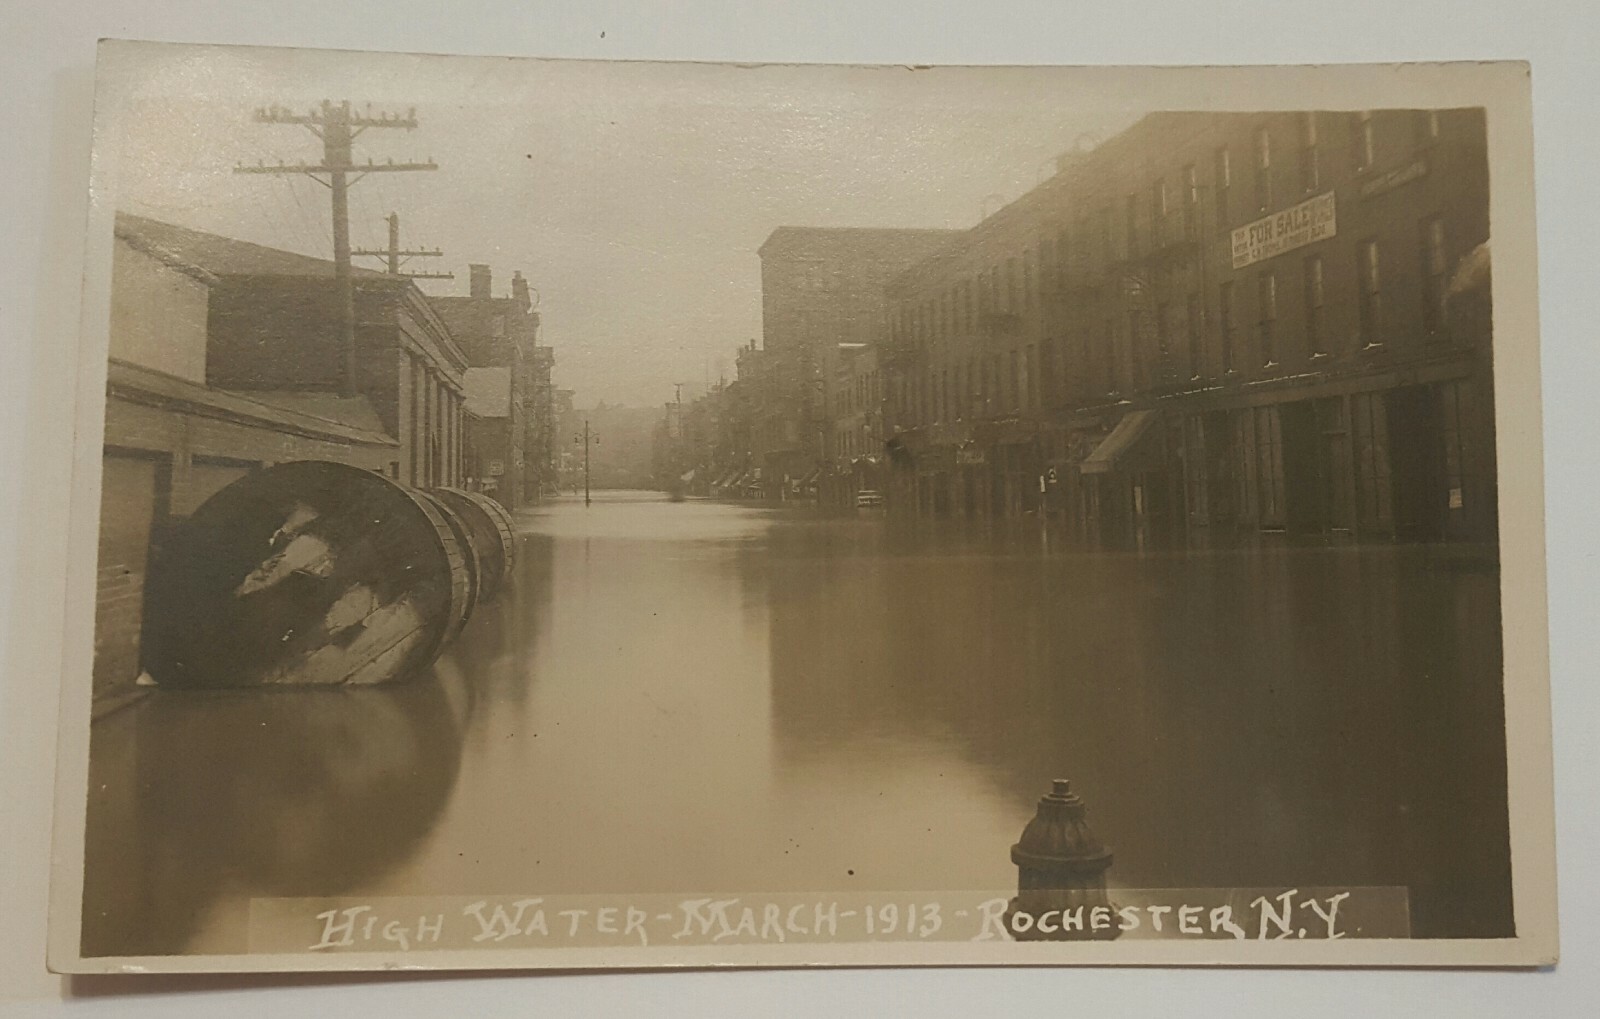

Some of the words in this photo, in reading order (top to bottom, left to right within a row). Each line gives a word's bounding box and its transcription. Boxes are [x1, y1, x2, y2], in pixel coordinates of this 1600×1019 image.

[1249, 221, 1273, 247] FOR
[1278, 205, 1311, 236] SALE
[308, 905, 444, 950] HIGH
[971, 898, 1246, 941] ROCHESTER
